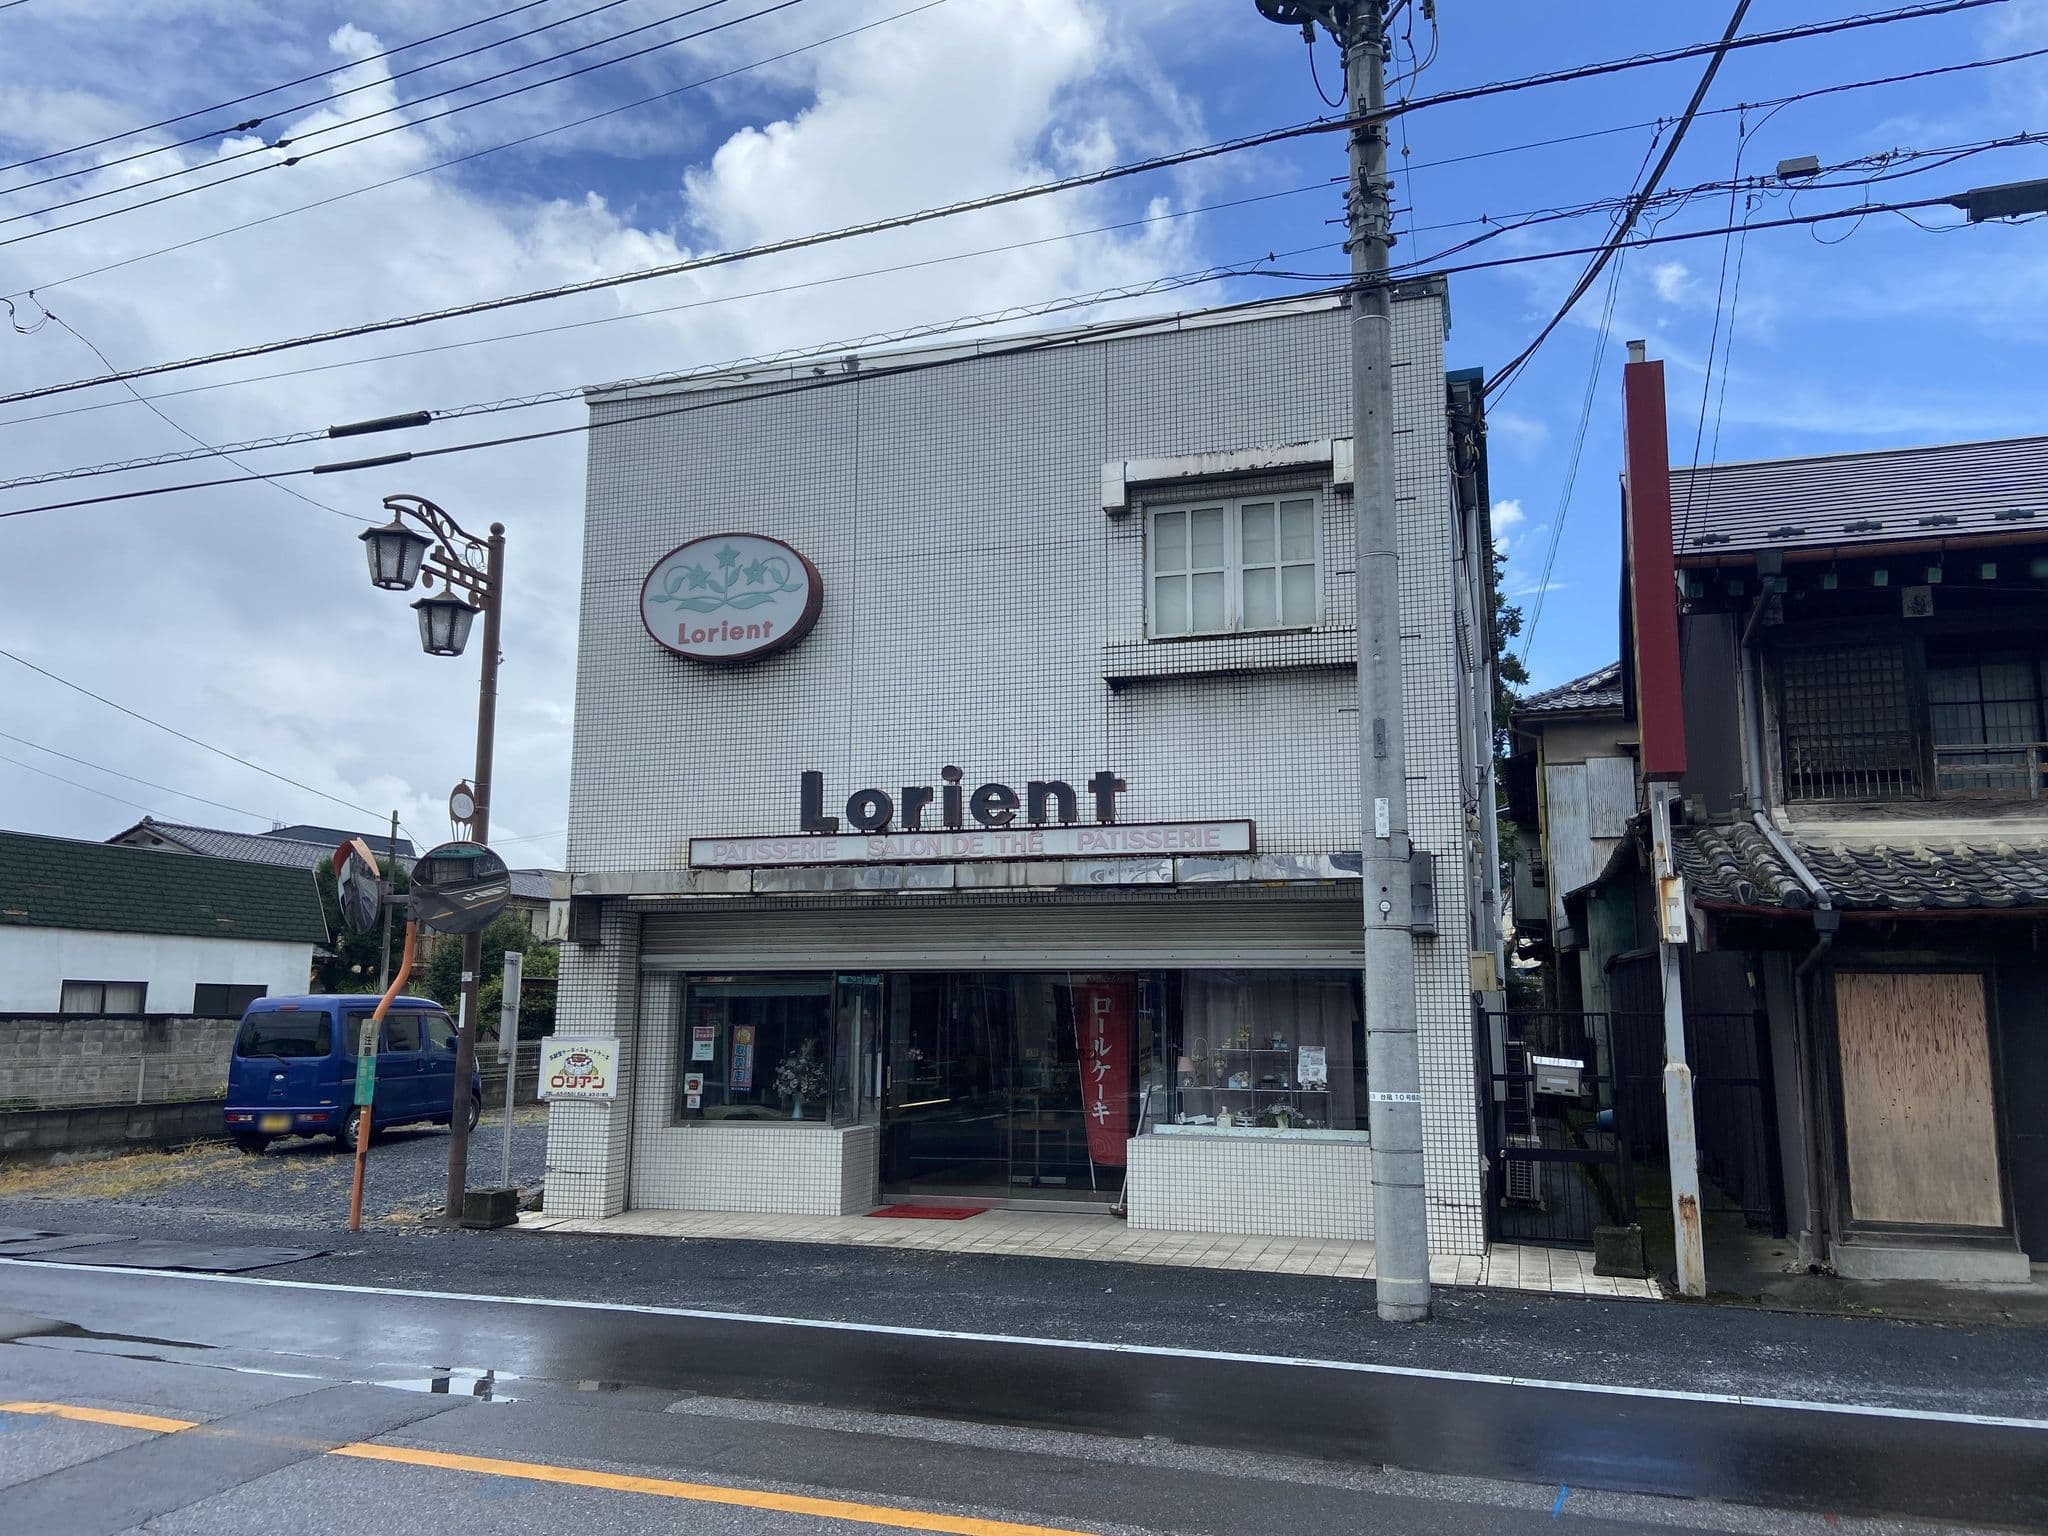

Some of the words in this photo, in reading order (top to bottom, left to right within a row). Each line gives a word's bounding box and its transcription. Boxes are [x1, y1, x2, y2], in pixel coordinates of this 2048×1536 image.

[677, 619, 773, 645] Lorient
[800, 765, 1127, 833] Lorient
[711, 837, 839, 862] PÂTISSERIE
[867, 835, 942, 858] SALON
[951, 834, 985, 856] DE
[1076, 827, 1222, 851] PÂTISSERIE
[1091, 996, 1113, 1126] ロールケーキ
[551, 1075, 605, 1089] ロリアン
